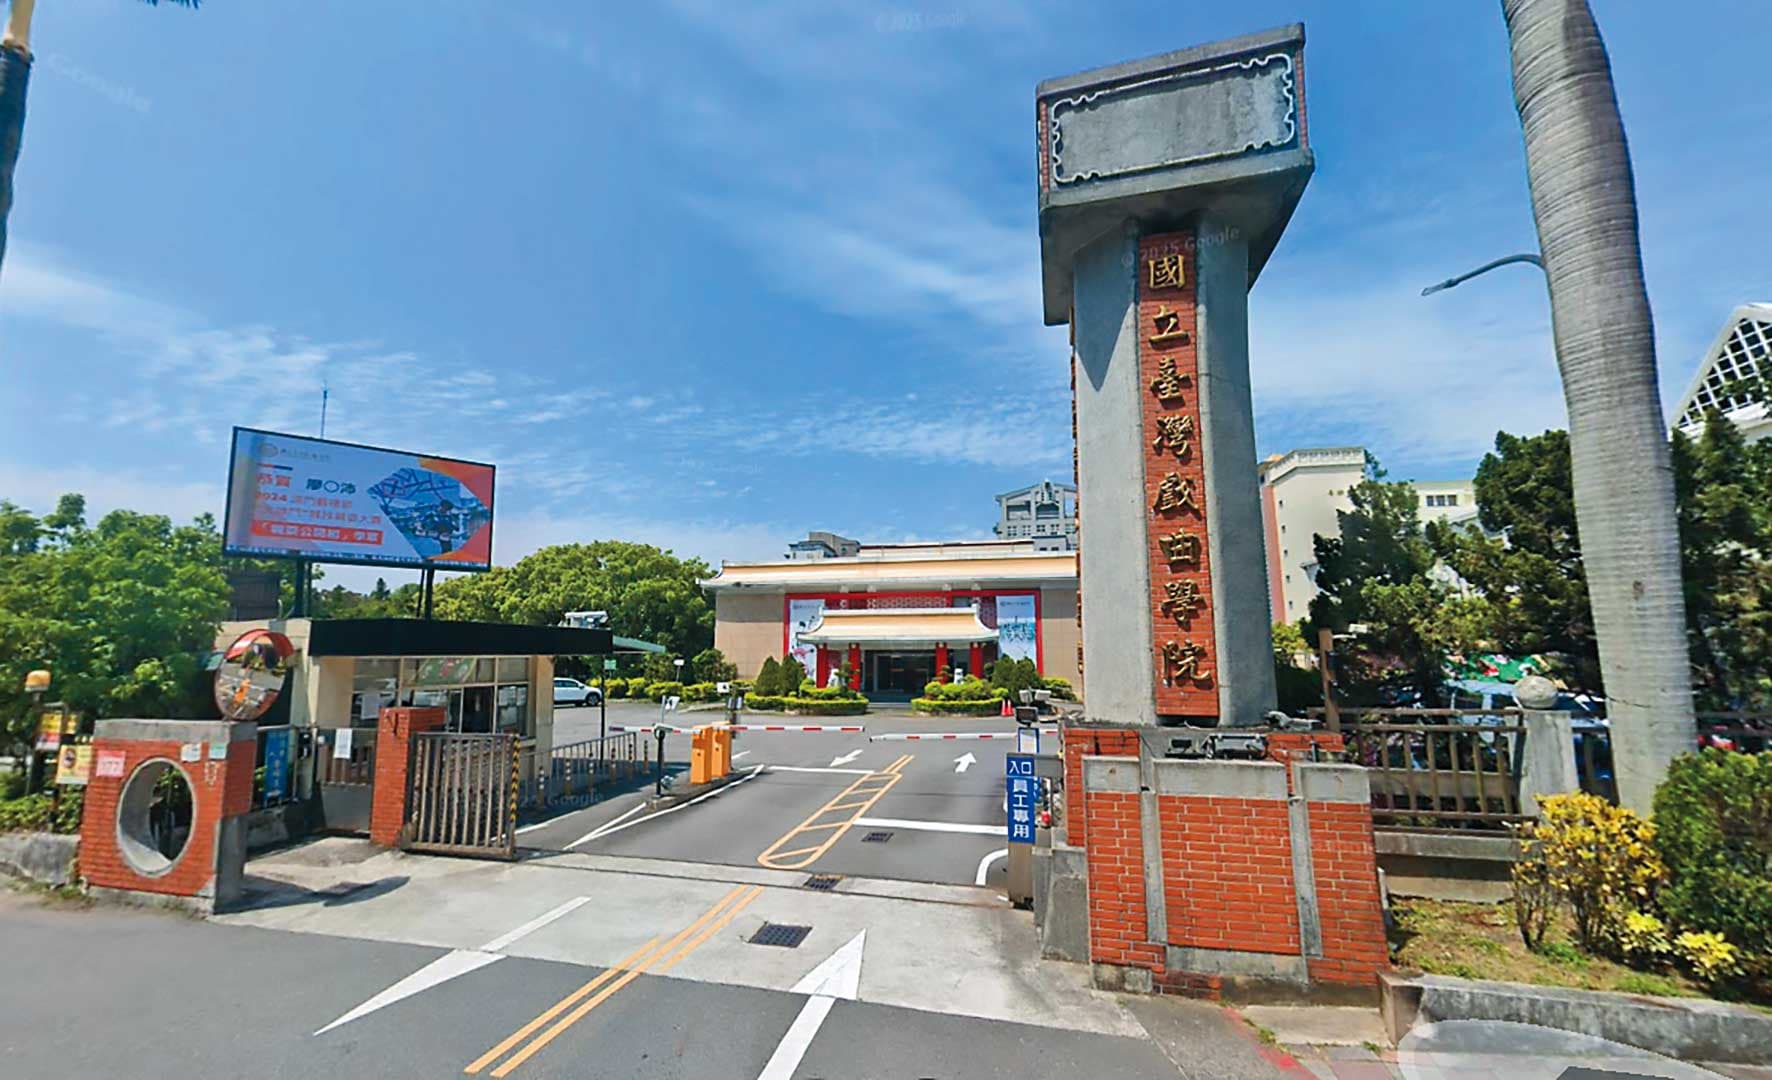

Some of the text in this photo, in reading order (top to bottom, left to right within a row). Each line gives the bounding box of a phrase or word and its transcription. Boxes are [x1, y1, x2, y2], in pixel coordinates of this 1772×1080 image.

[1149, 253, 1212, 686] 國立臺灣戲曲學院
[1009, 760, 1032, 775] 入口
[1013, 779, 1029, 838] 員工專用
